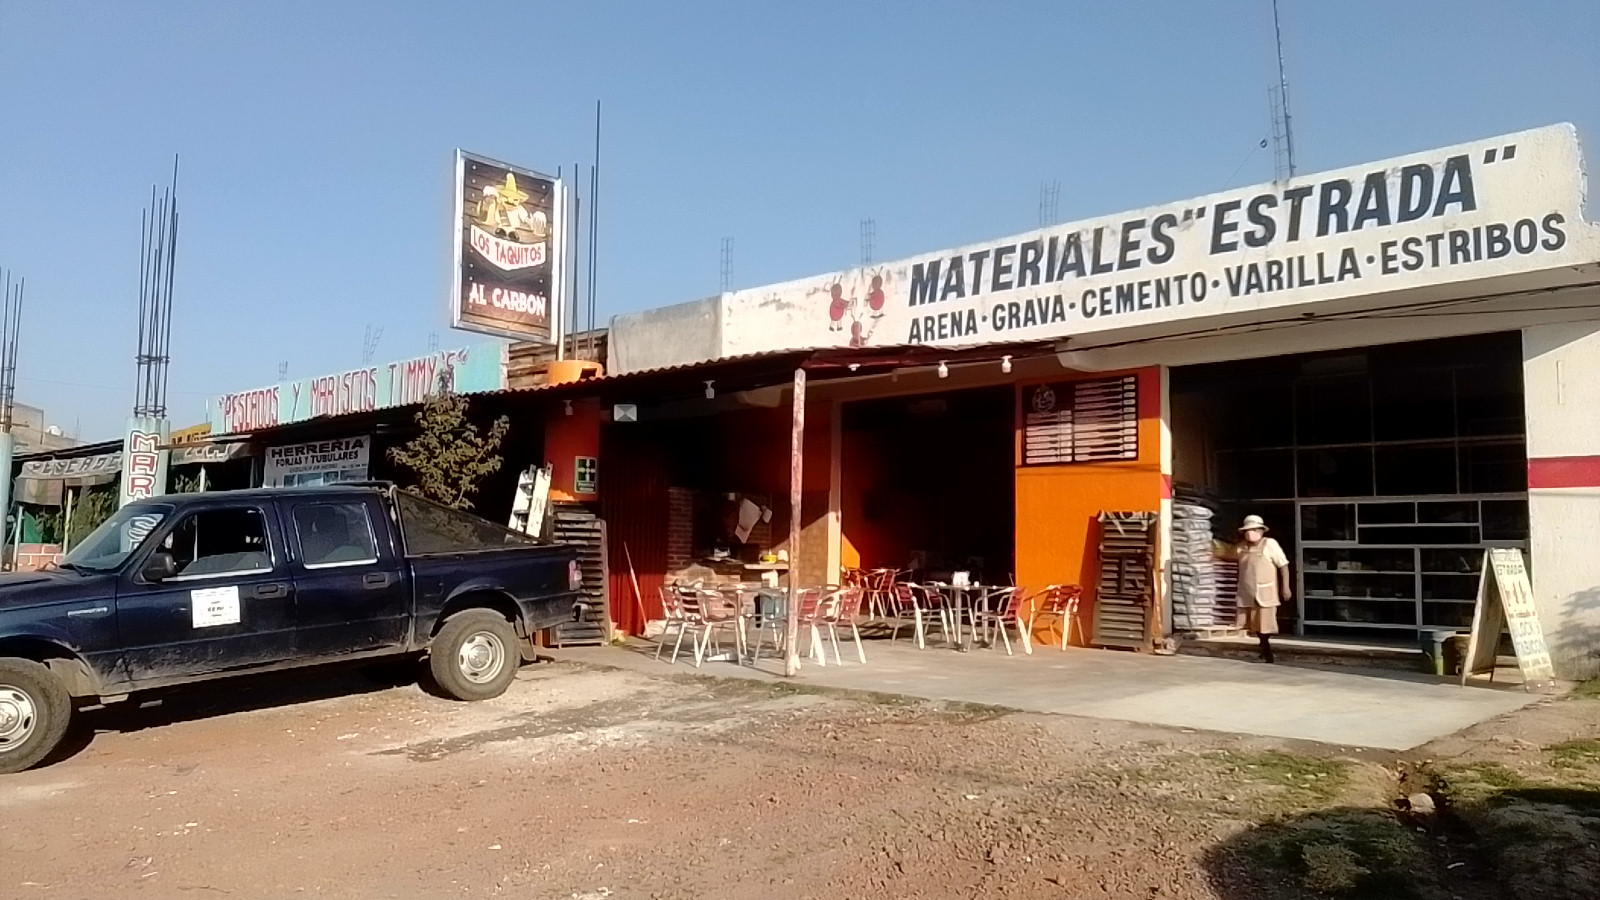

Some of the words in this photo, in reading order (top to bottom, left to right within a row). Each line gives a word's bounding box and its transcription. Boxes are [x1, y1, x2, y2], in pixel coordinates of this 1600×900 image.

[473, 229, 490, 255] LOS
[494, 241, 542, 265] TAQUITOS
[908, 213, 1178, 308] MATERIALES
[908, 308, 978, 344] ARENA
[992, 294, 1067, 332] GRAVA
[1081, 271, 1207, 318] CEMENTO
[1224, 247, 1361, 298] VARILLA
[1381, 212, 1566, 276] ESTRIBOS
[469, 282, 487, 306] AL
[492, 287, 546, 317] CARBON
[292, 381, 302, 424] Y
[272, 439, 364, 459] HERRERIA
[303, 456, 309, 465] Y
[310, 450, 359, 464] TUBULARES
